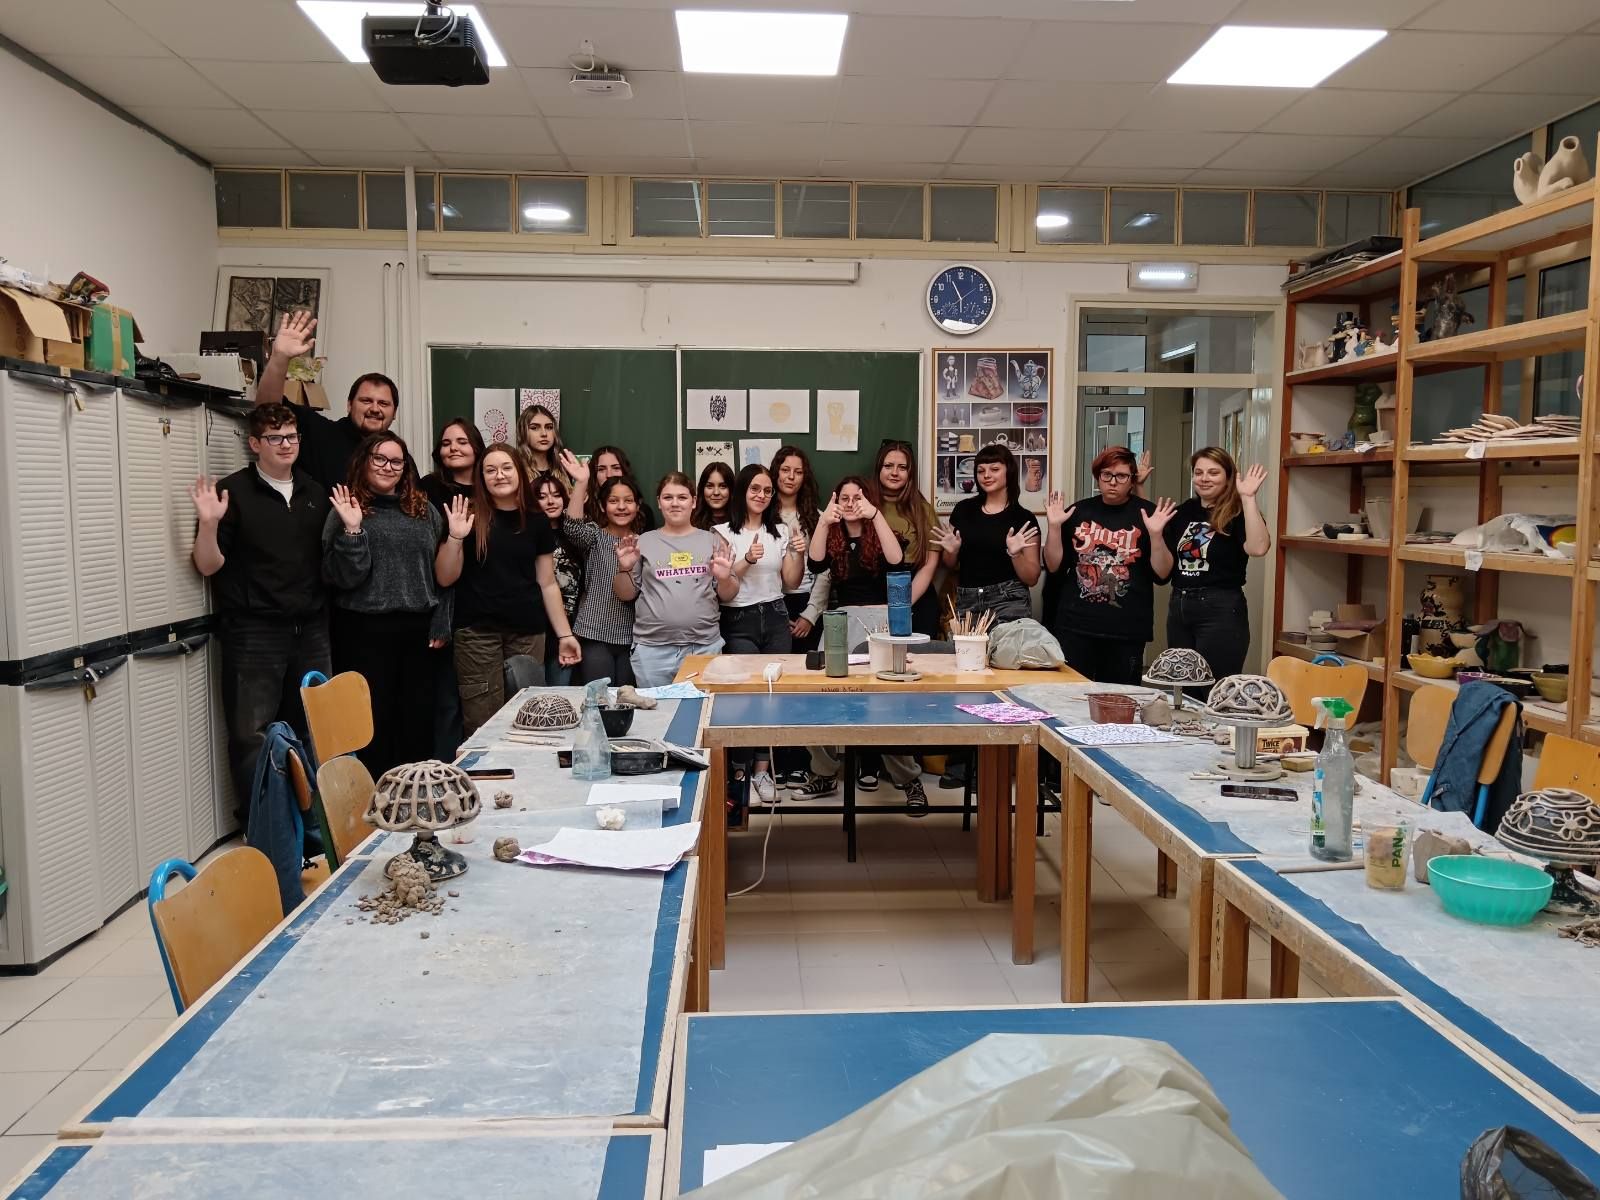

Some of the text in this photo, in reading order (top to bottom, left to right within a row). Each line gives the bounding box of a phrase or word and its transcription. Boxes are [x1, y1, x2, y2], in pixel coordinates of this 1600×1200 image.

[945, 272, 951, 283] 11
[958, 272, 964, 280] 12
[656, 566, 707, 577] WHATEVER
